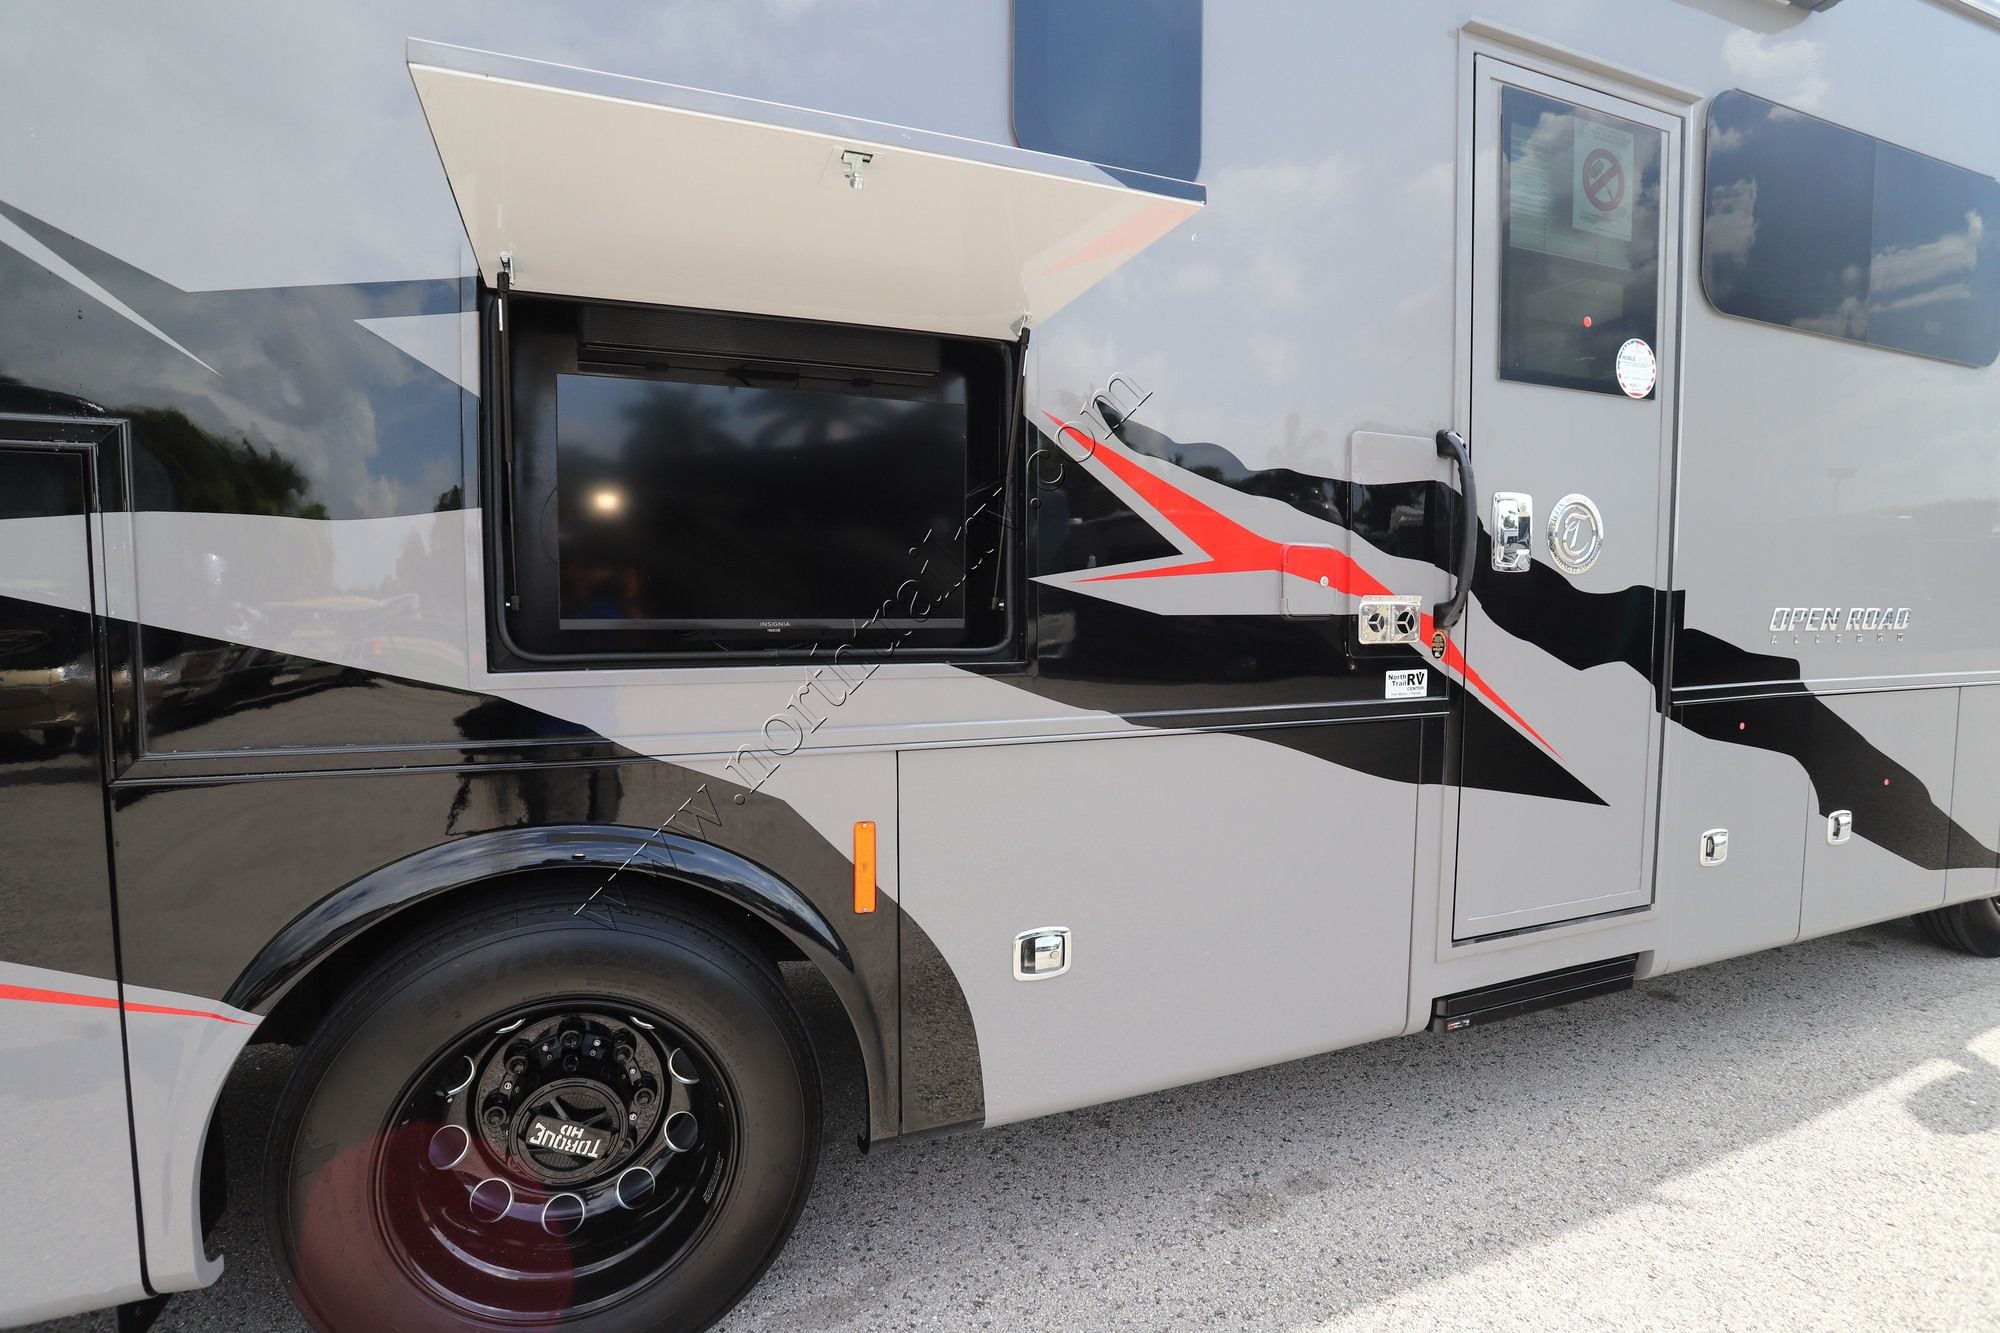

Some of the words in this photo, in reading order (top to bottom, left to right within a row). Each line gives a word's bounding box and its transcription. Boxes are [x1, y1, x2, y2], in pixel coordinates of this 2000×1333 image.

[1769, 607, 1842, 632] OPEN
[1845, 607, 1912, 632] ROAD
[1407, 671, 1425, 686] RV
[530, 1121, 603, 1159] TORQUE
[559, 1124, 585, 1138] HD
